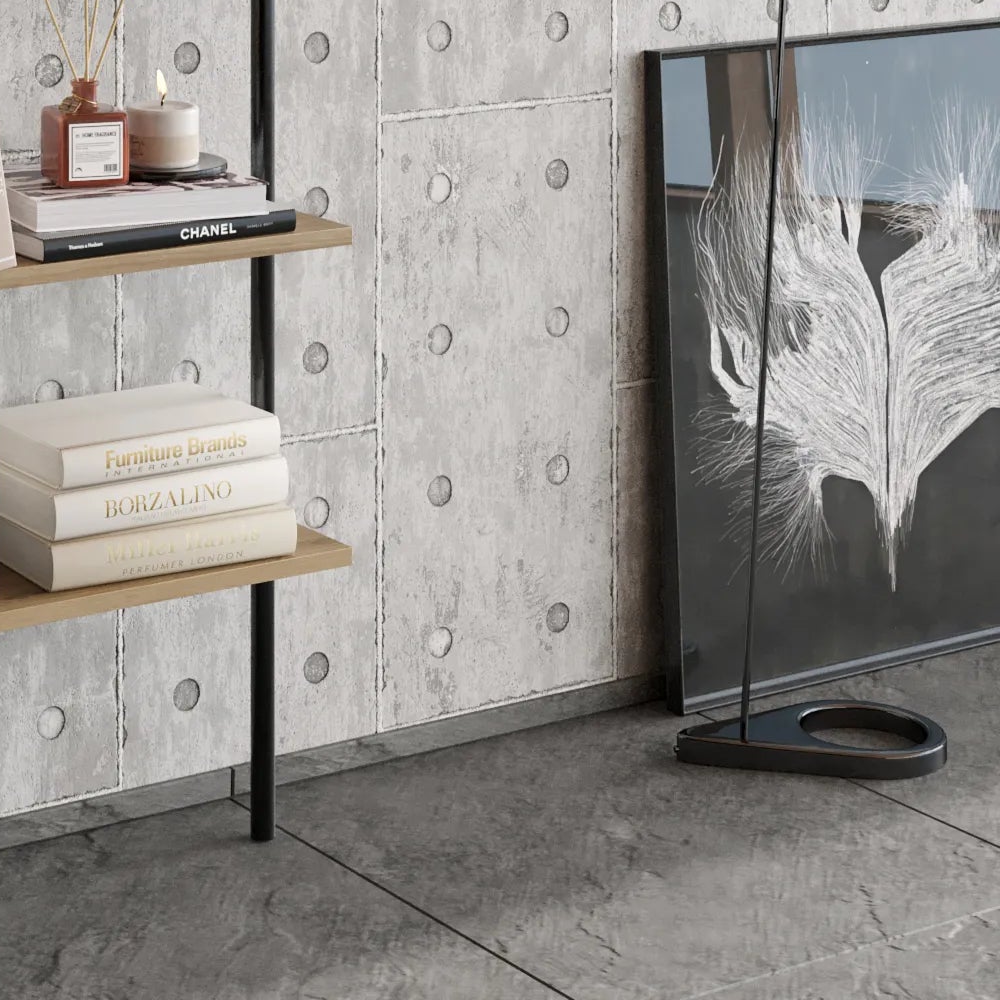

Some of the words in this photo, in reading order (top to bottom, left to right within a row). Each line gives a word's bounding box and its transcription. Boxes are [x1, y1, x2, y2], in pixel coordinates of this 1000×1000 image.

[180, 222, 237, 241] CHANEL
[105, 443, 183, 470] Furniture
[187, 431, 248, 456] Brands
[105, 480, 232, 519] BORZALINO
[106, 533, 176, 565] Miller
[185, 523, 261, 552] Harris
[122, 559, 184, 577] PERFUMER
[190, 550, 245, 566] LONDON
